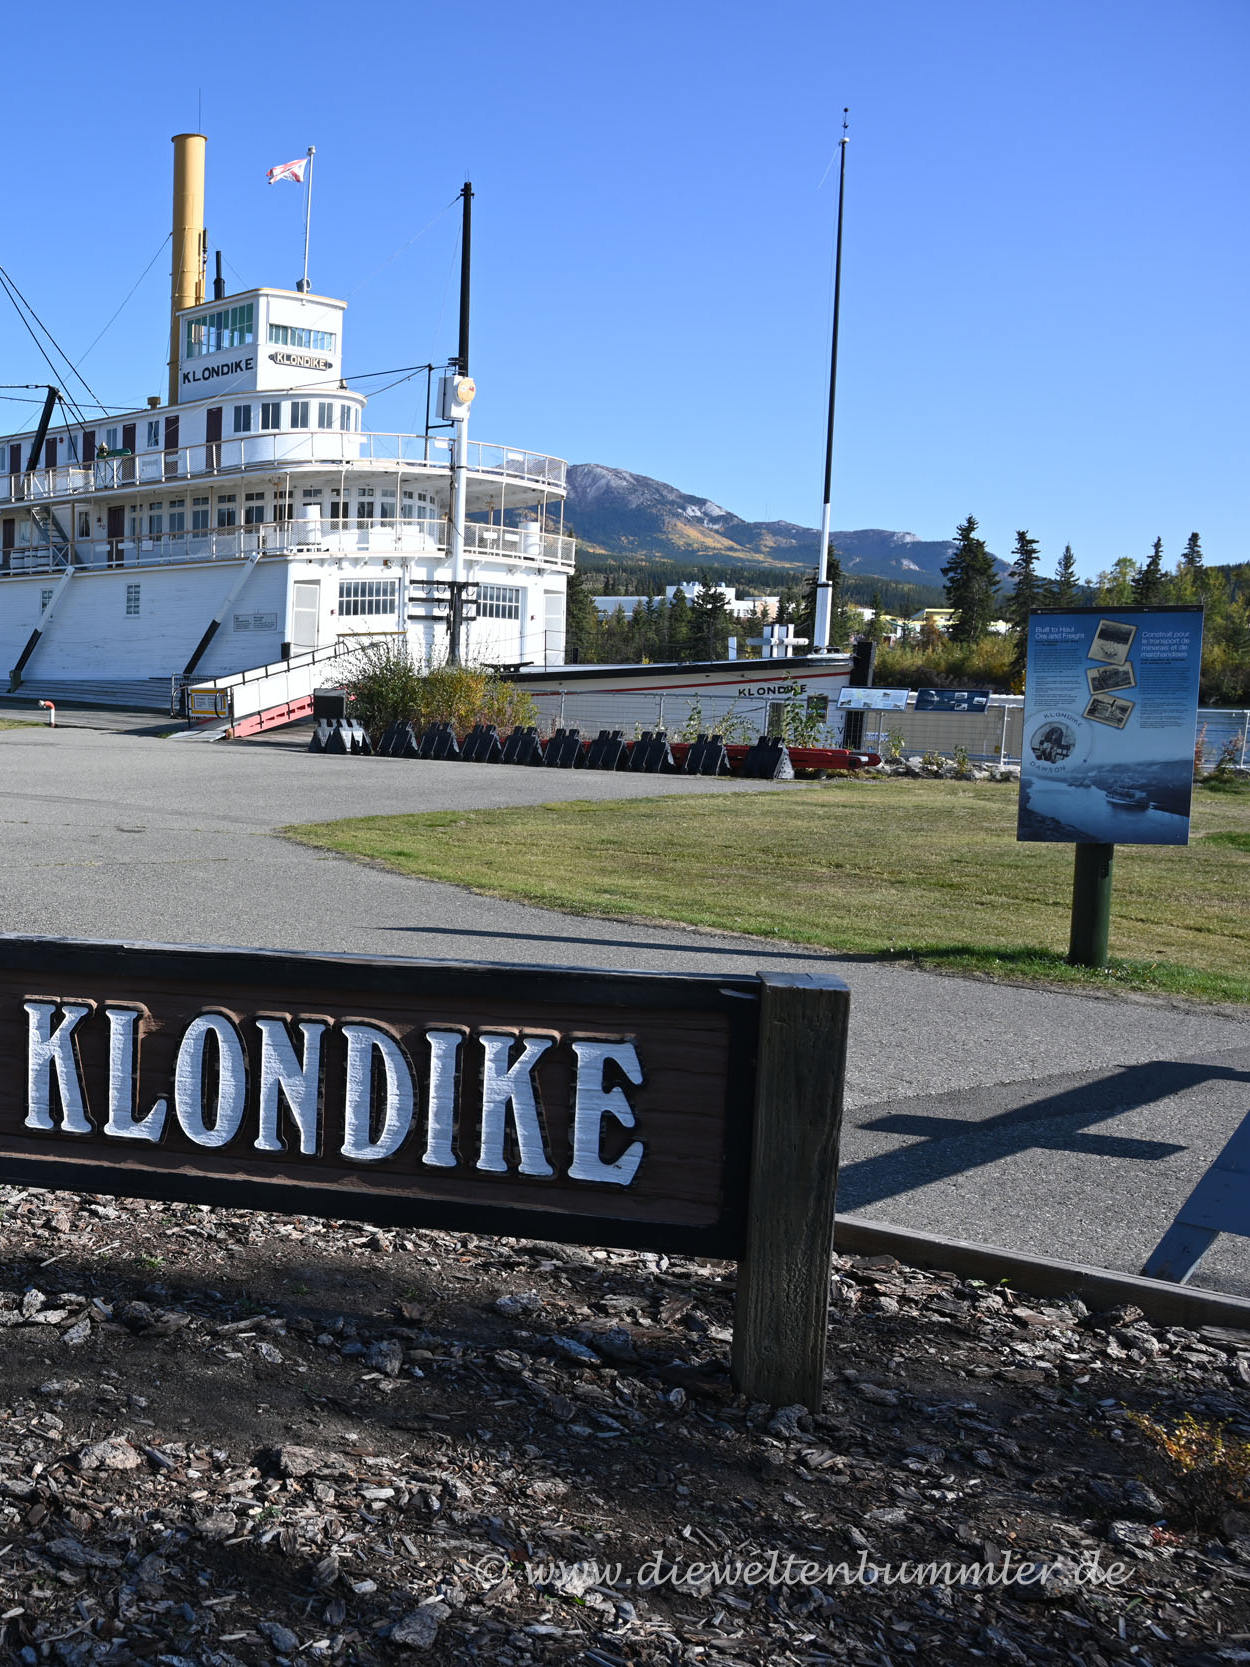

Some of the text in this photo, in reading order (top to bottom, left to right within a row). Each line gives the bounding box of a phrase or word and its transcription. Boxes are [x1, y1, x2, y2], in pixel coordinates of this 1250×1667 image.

[276, 352, 327, 369] KLONDIKE
[182, 357, 254, 385] KLONDIKE
[1149, 638, 1180, 646] transport
[1043, 712, 1083, 728] KLONDIKE
[1030, 761, 1066, 773] DAWSON
[23, 1001, 645, 1187] KLONDIKE
